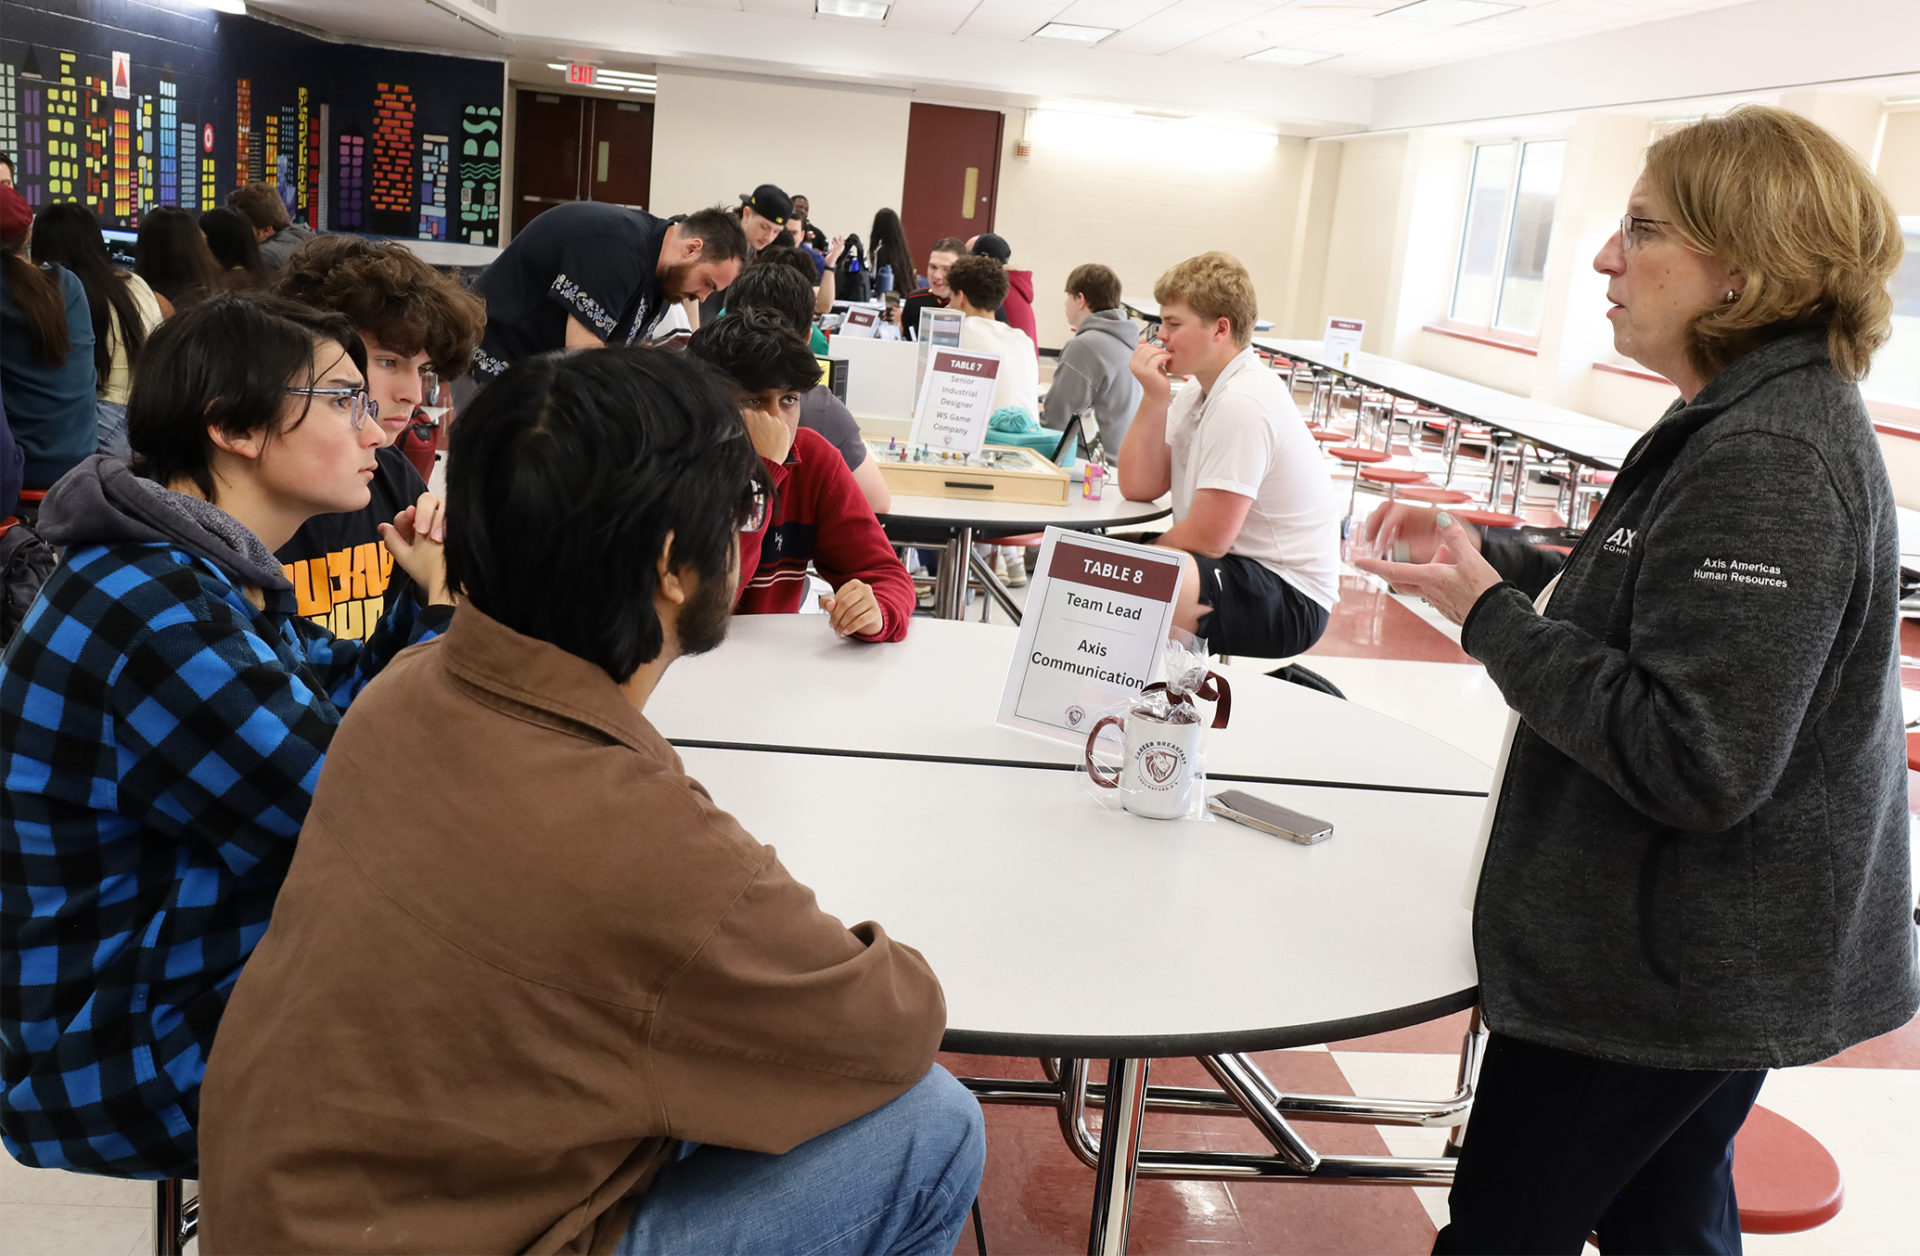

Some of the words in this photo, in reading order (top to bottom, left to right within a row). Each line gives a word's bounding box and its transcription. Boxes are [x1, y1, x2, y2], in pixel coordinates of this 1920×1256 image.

[570, 64, 594, 84] EXIT
[951, 359, 976, 371] TABLE
[976, 363, 983, 372] 7
[950, 375, 975, 385] Senior
[942, 386, 978, 398] Industrial
[940, 398, 974, 409] Designer
[936, 411, 948, 419] WS
[949, 413, 971, 423] Game
[933, 422, 969, 436] Company
[1606, 527, 1637, 548] AX
[1083, 559, 1130, 583] TABLE
[1132, 569, 1144, 585] 8
[1703, 557, 1727, 569] Axis
[1730, 559, 1781, 575] Americas
[1693, 568, 1728, 581] Human
[1731, 572, 1788, 588] Resources
[1066, 592, 1103, 613] Team
[1106, 601, 1143, 621] Lead
[1077, 639, 1108, 658] Axis
[1031, 651, 1145, 690] Communication
[1135, 741, 1155, 760] CAREER
[1157, 741, 1187, 765] BREAKFAST
[1137, 775, 1169, 792] CHELMSFORD
